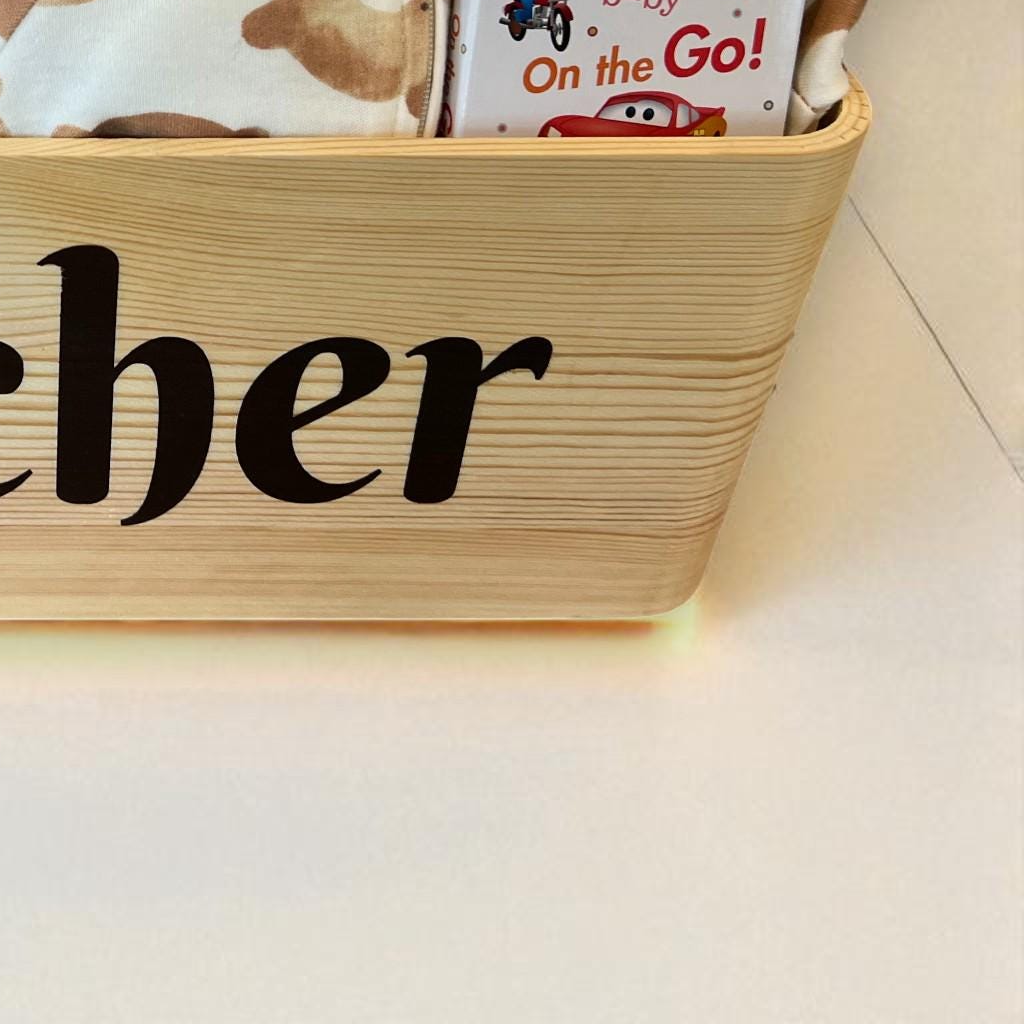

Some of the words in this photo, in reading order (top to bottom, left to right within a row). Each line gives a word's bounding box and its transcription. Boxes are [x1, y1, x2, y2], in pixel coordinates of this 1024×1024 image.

[522, 56, 581, 94] On
[596, 45, 654, 86] the
[664, 18, 766, 78] Go!
